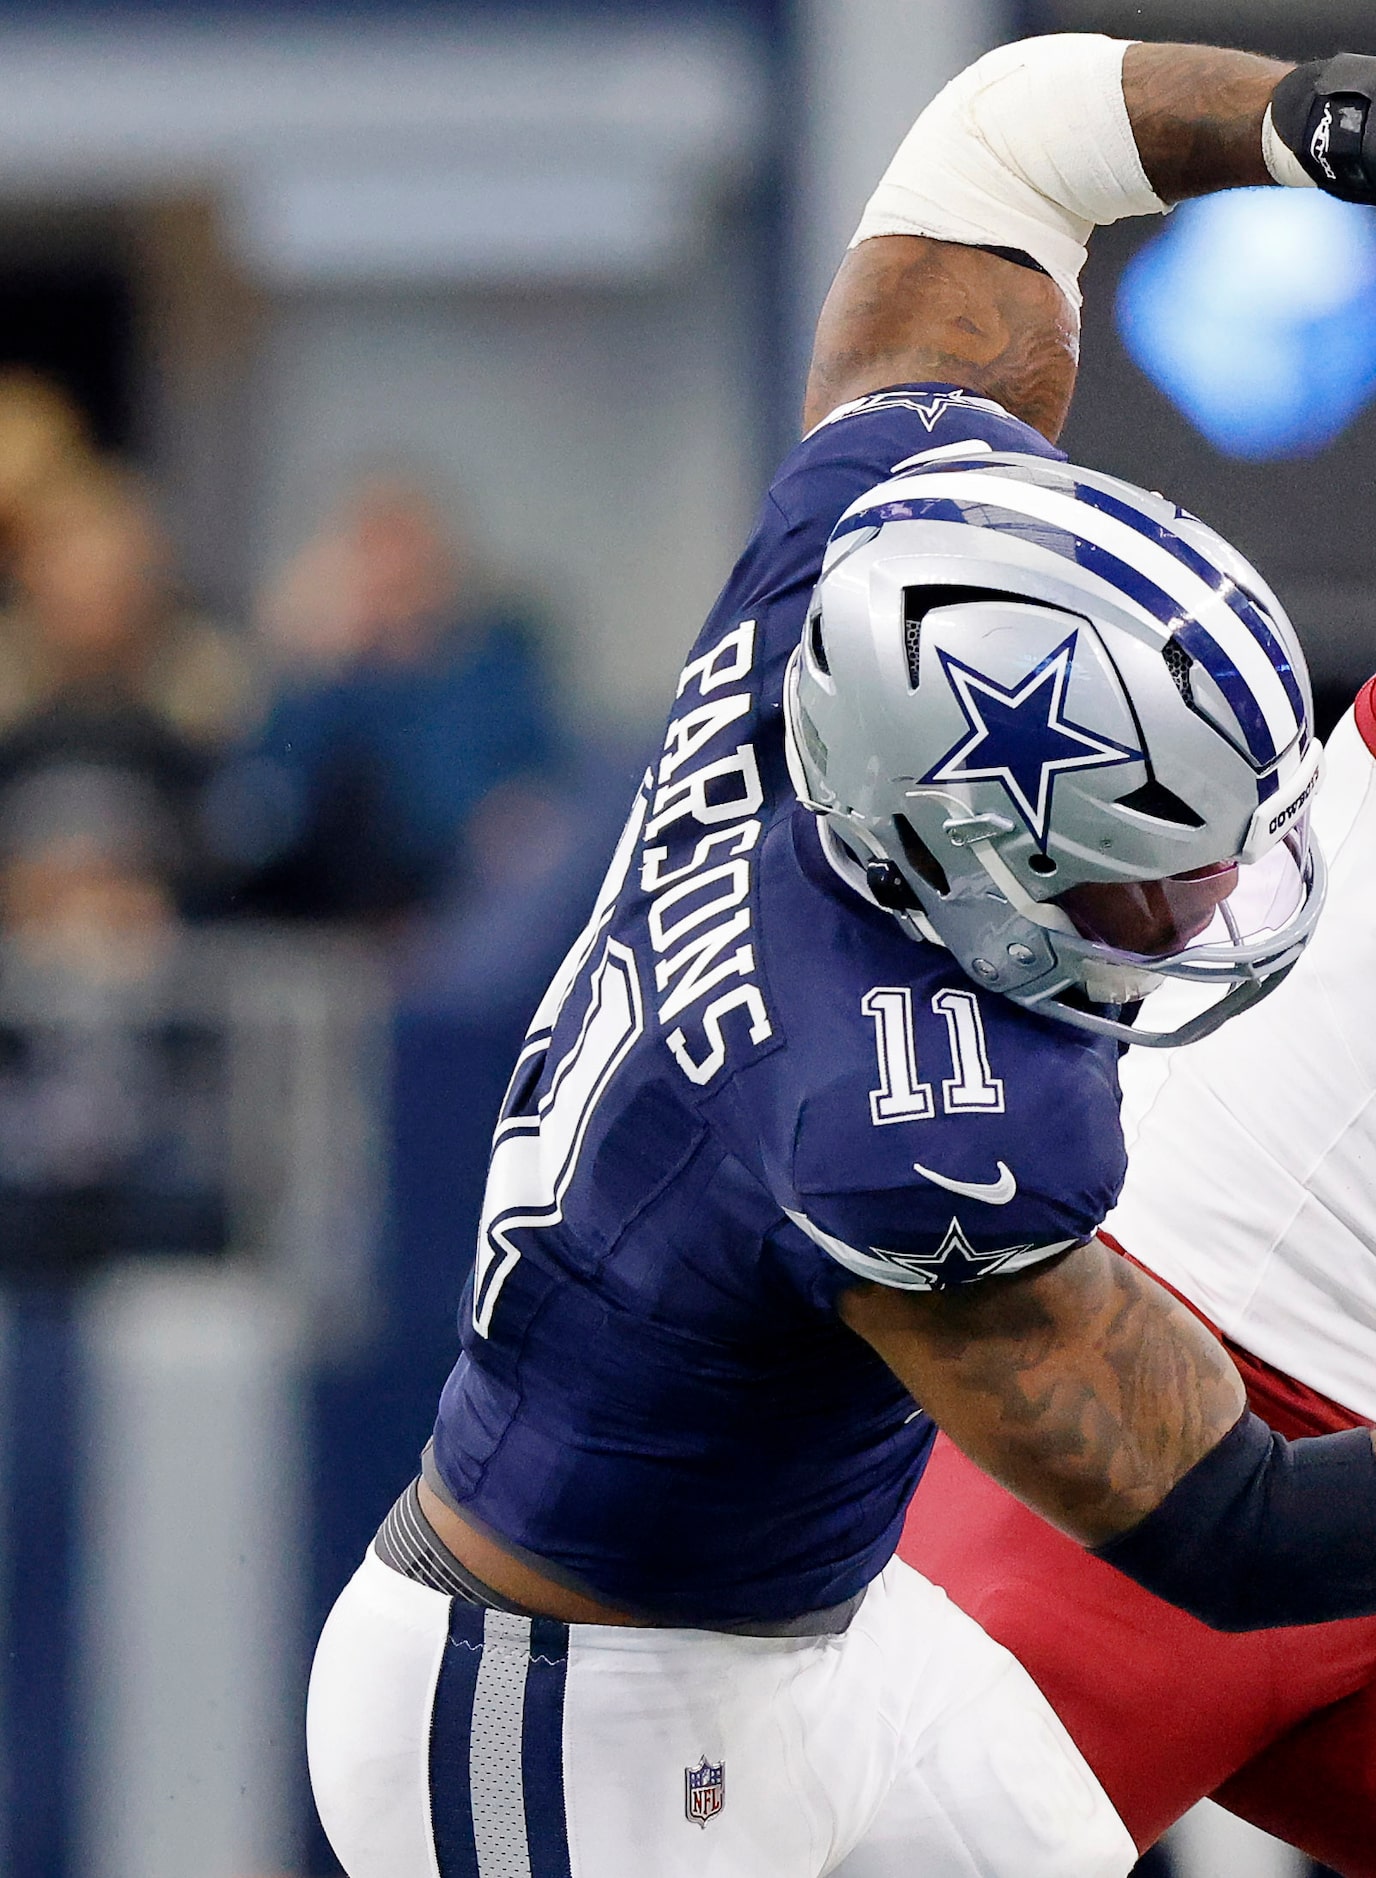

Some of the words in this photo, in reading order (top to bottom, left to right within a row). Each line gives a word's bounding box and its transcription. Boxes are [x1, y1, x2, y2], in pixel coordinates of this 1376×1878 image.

[641, 620, 772, 1086] PARSONS
[861, 986, 1005, 1125] 11
[693, 1787, 719, 1815] NFL
